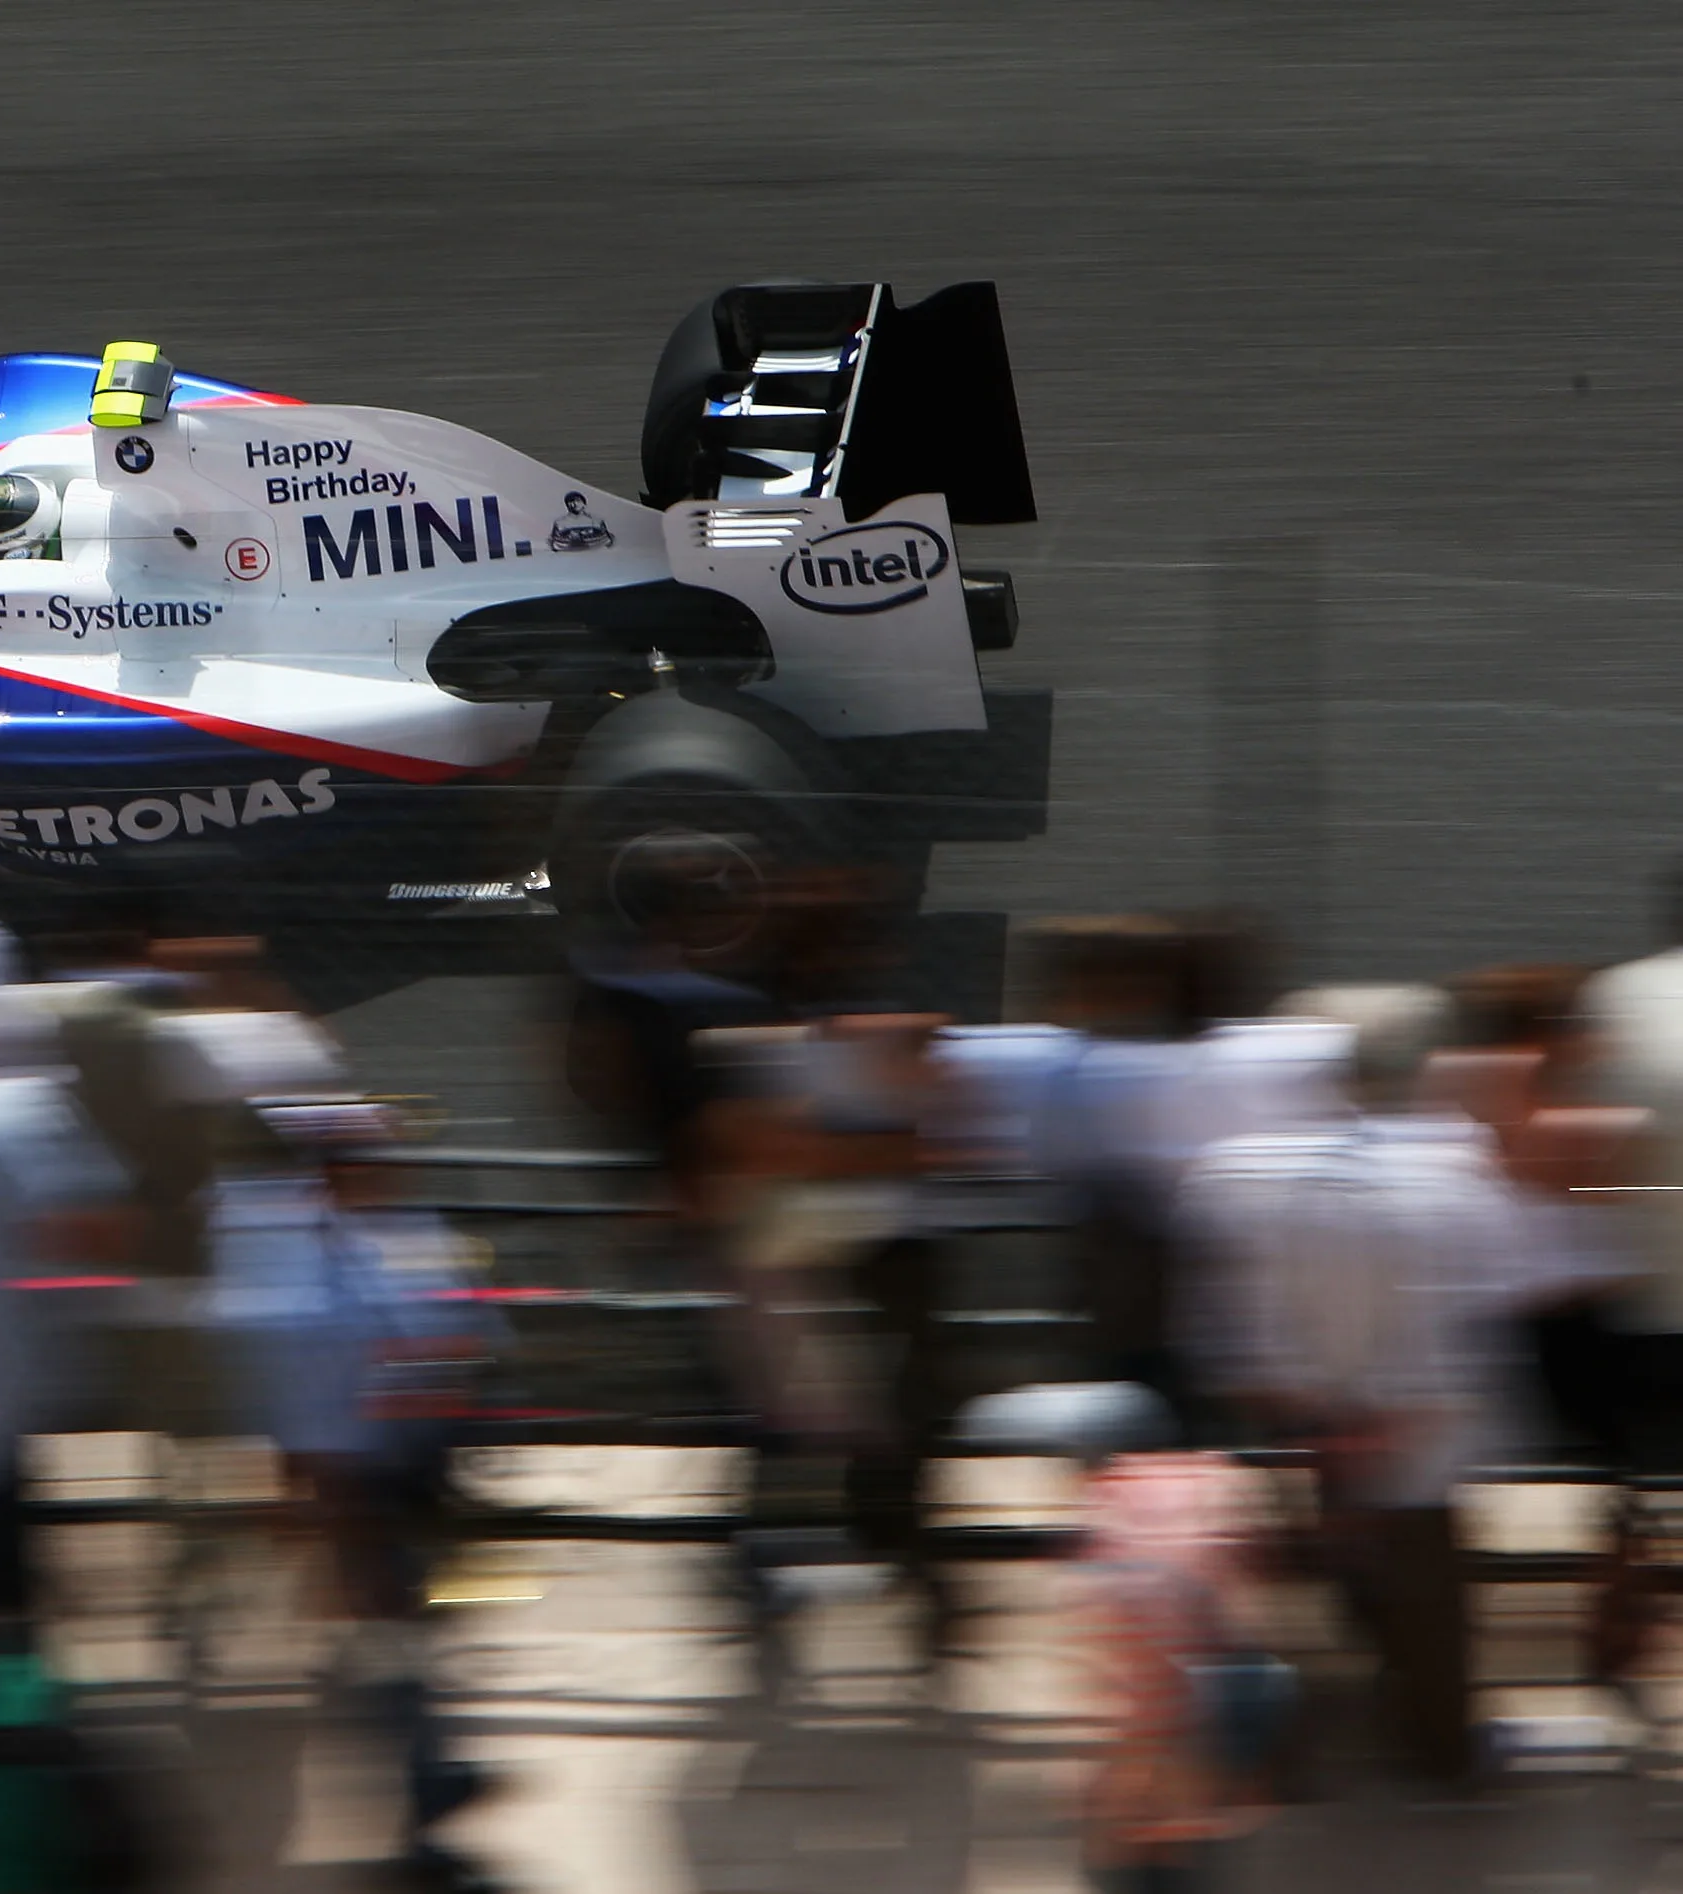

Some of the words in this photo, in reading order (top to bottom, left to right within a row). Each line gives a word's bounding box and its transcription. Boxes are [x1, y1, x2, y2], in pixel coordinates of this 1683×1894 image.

[245, 439, 352, 469] Happy
[266, 468, 416, 504] Birthday,
[302, 495, 532, 582] MINI.
[238, 547, 258, 570] E
[799, 539, 923, 588] intel
